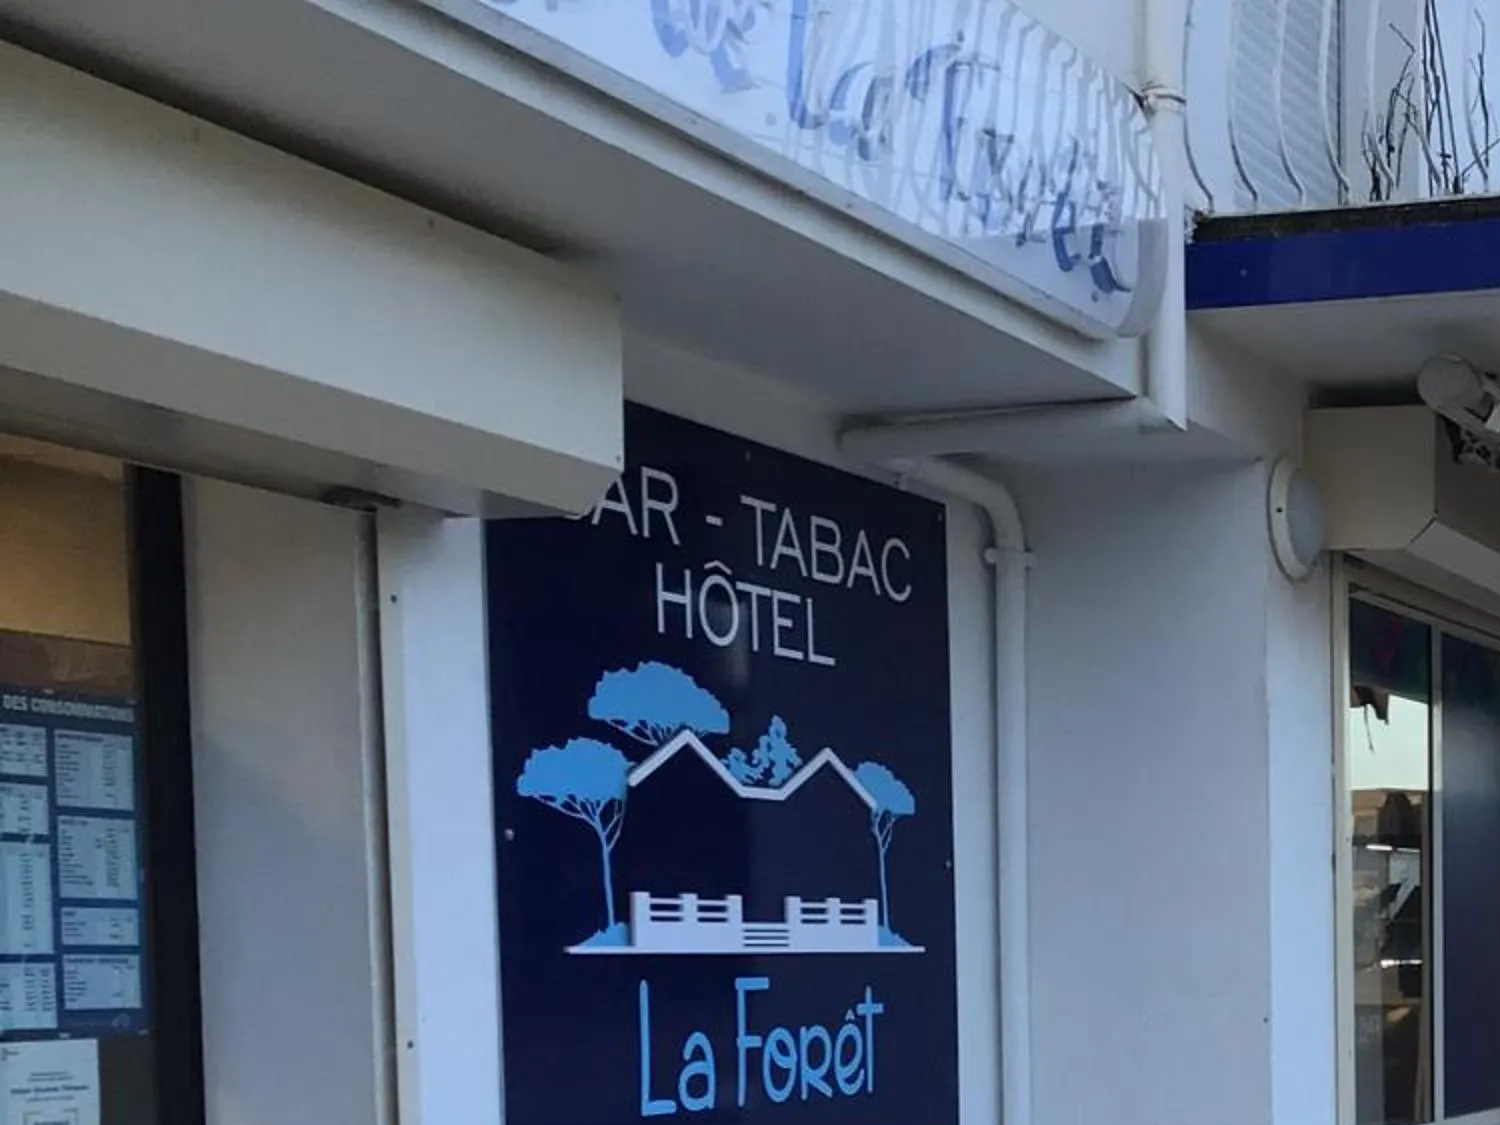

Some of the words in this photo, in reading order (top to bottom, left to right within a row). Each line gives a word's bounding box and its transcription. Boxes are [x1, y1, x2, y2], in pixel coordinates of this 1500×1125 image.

[565, 466, 681, 545] AR
[740, 495, 911, 601] TABAC
[656, 560, 835, 666] HÔTEL
[640, 979, 716, 1117] La
[734, 977, 884, 1106] Forêt
